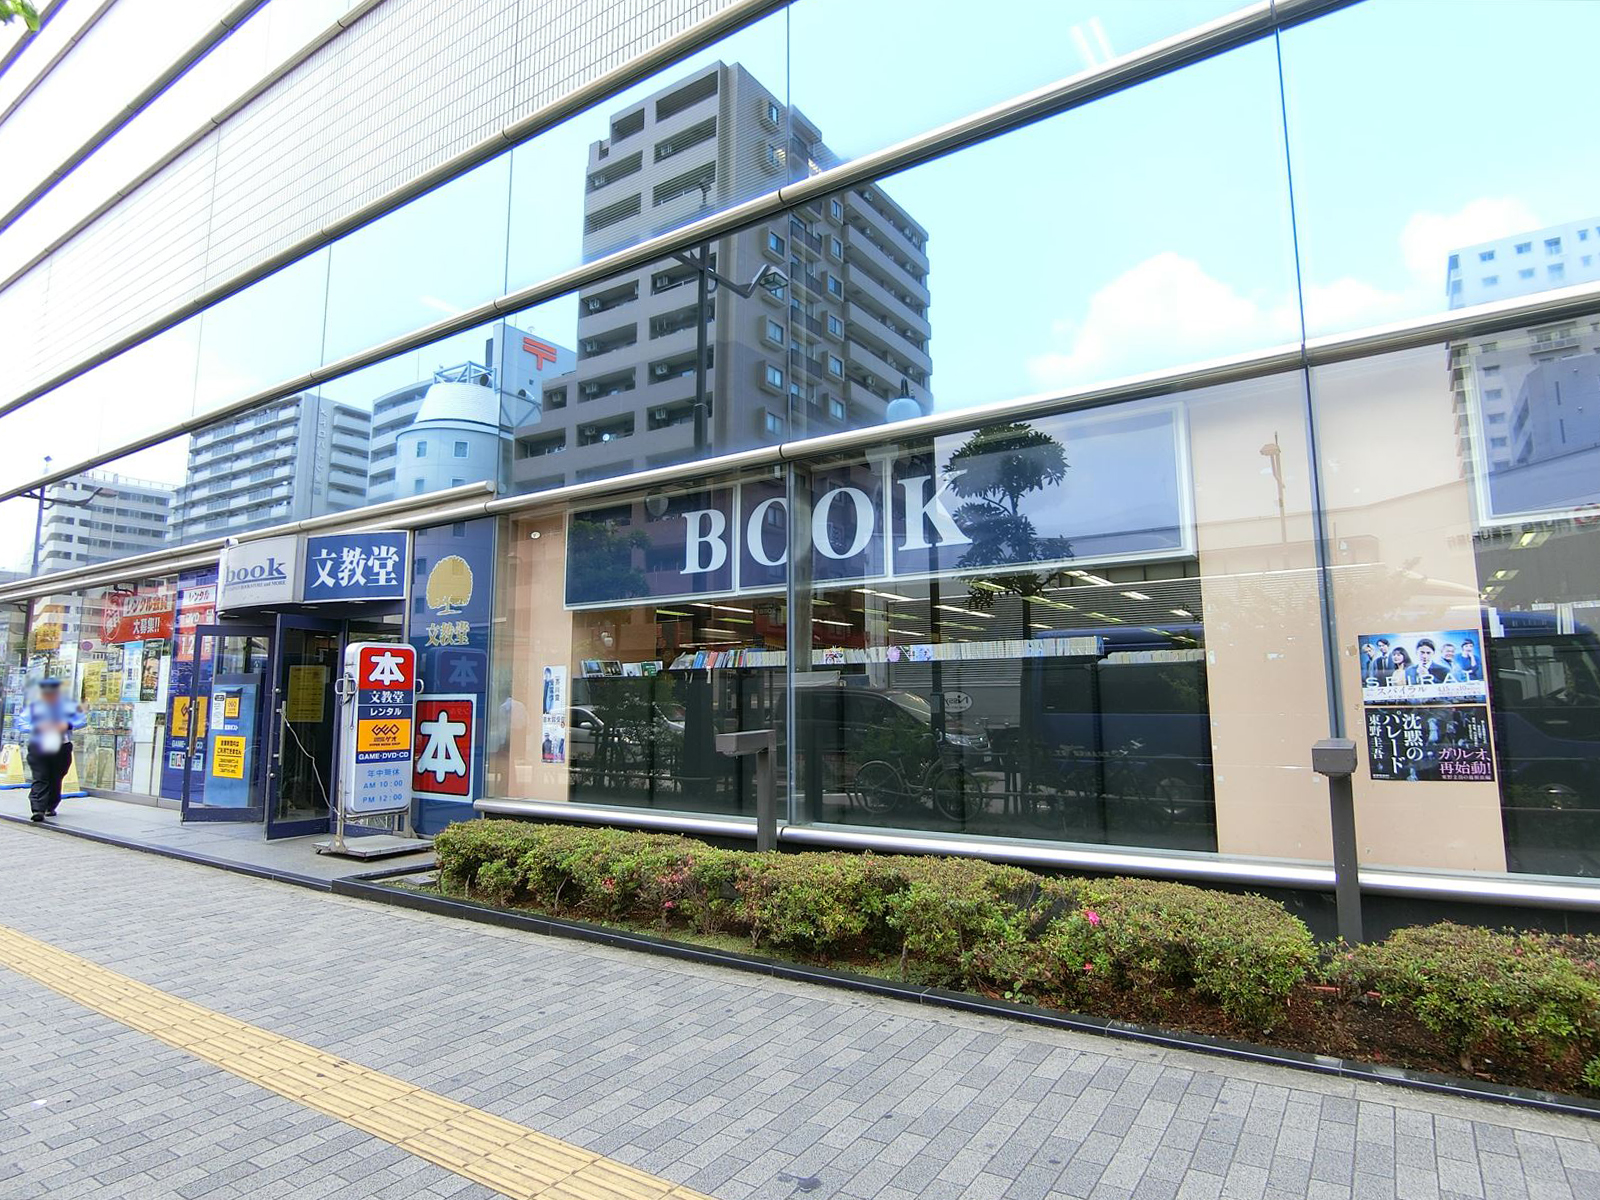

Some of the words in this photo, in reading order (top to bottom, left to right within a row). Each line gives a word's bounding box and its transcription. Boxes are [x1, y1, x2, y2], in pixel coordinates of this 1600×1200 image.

[680, 469, 973, 575] BOOK
[225, 557, 287, 583] book
[310, 545, 400, 588] 文教堂
[188, 590, 211, 602] レンタル
[425, 621, 470, 647] 文教堂
[368, 651, 405, 686] 本
[368, 690, 404, 704] 文教堂
[1377, 686, 1427, 697] スパイラル
[369, 707, 402, 716] レンタル
[371, 723, 400, 736] GEO
[1369, 714, 1385, 760] 東野圭吾
[1382, 710, 1406, 774] パレード
[1401, 713, 1424, 761] 沈黙の
[416, 710, 467, 783] 本
[367, 768, 400, 778] 年中無休
[379, 779, 403, 788] 10:00
[362, 796, 375, 804] PM
[379, 793, 402, 803] 12:00
